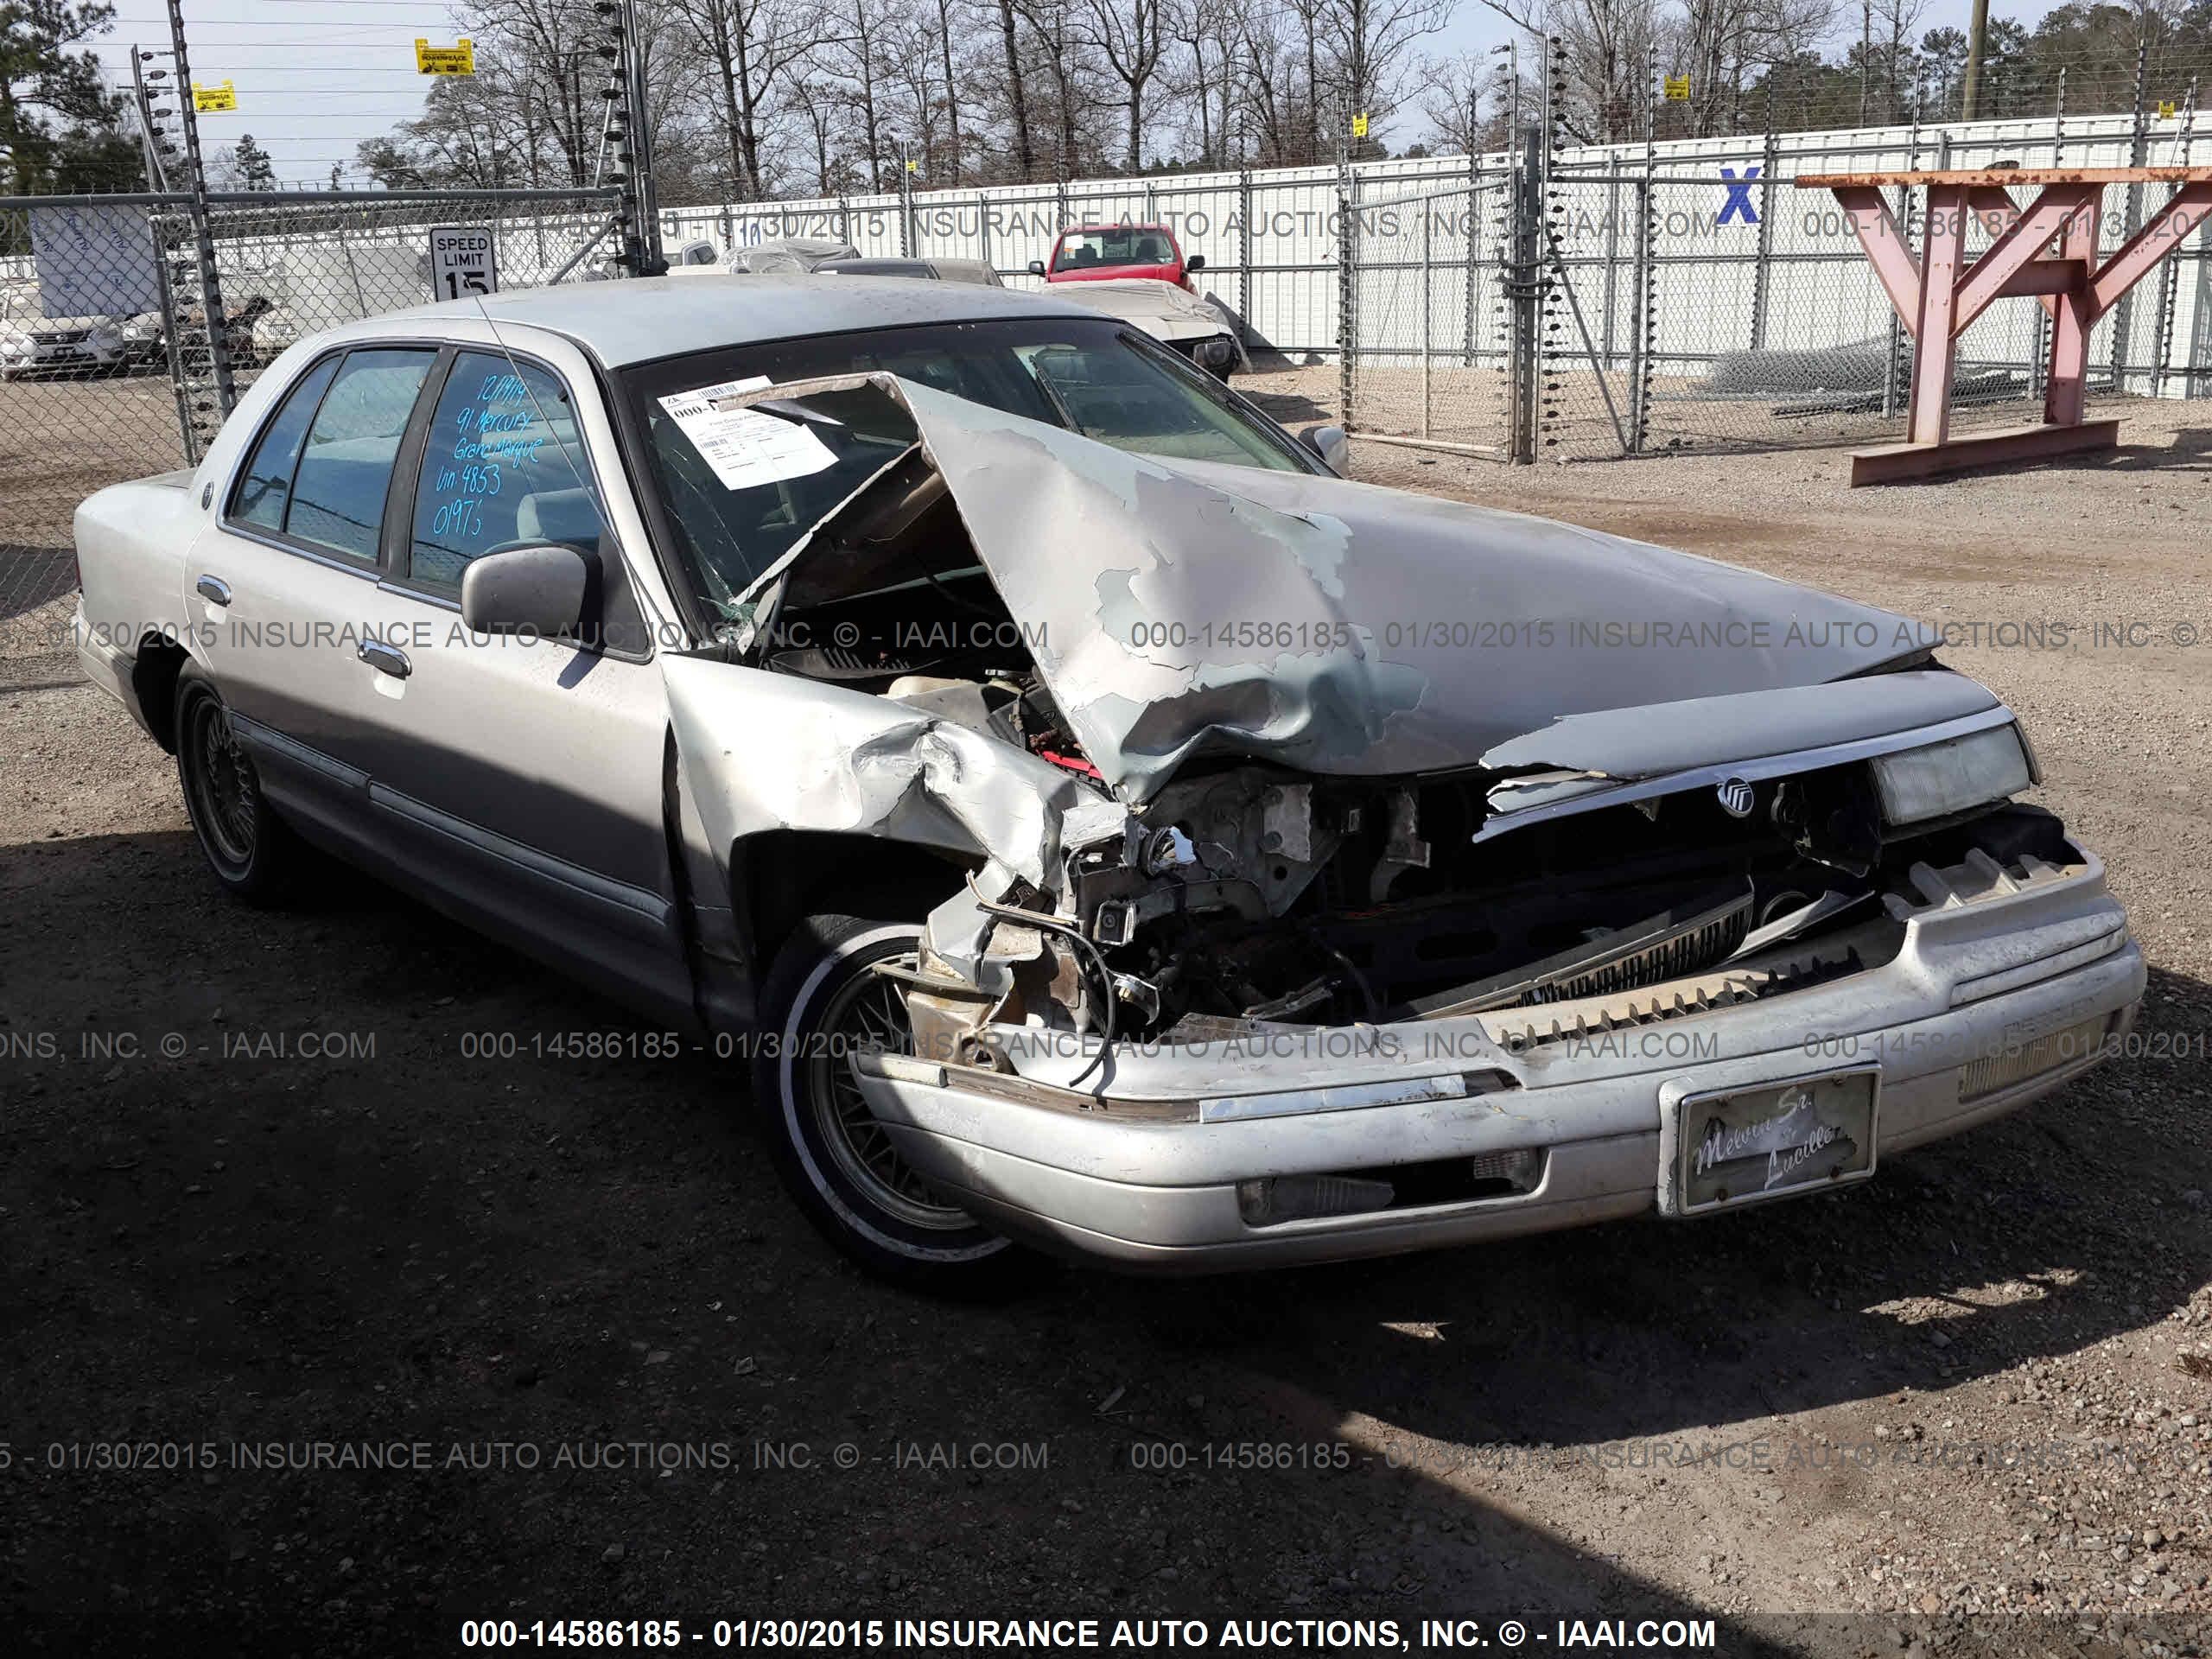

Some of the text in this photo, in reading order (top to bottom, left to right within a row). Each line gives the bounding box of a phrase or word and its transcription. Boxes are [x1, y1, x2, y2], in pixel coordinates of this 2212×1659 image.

[1717, 166, 1762, 225] X
[437, 238, 488, 251] SPEED
[444, 253, 484, 266] LIMIT
[446, 271, 489, 299] 15
[456, 408, 534, 435] 91 Mercury
[462, 464, 502, 495] 4853
